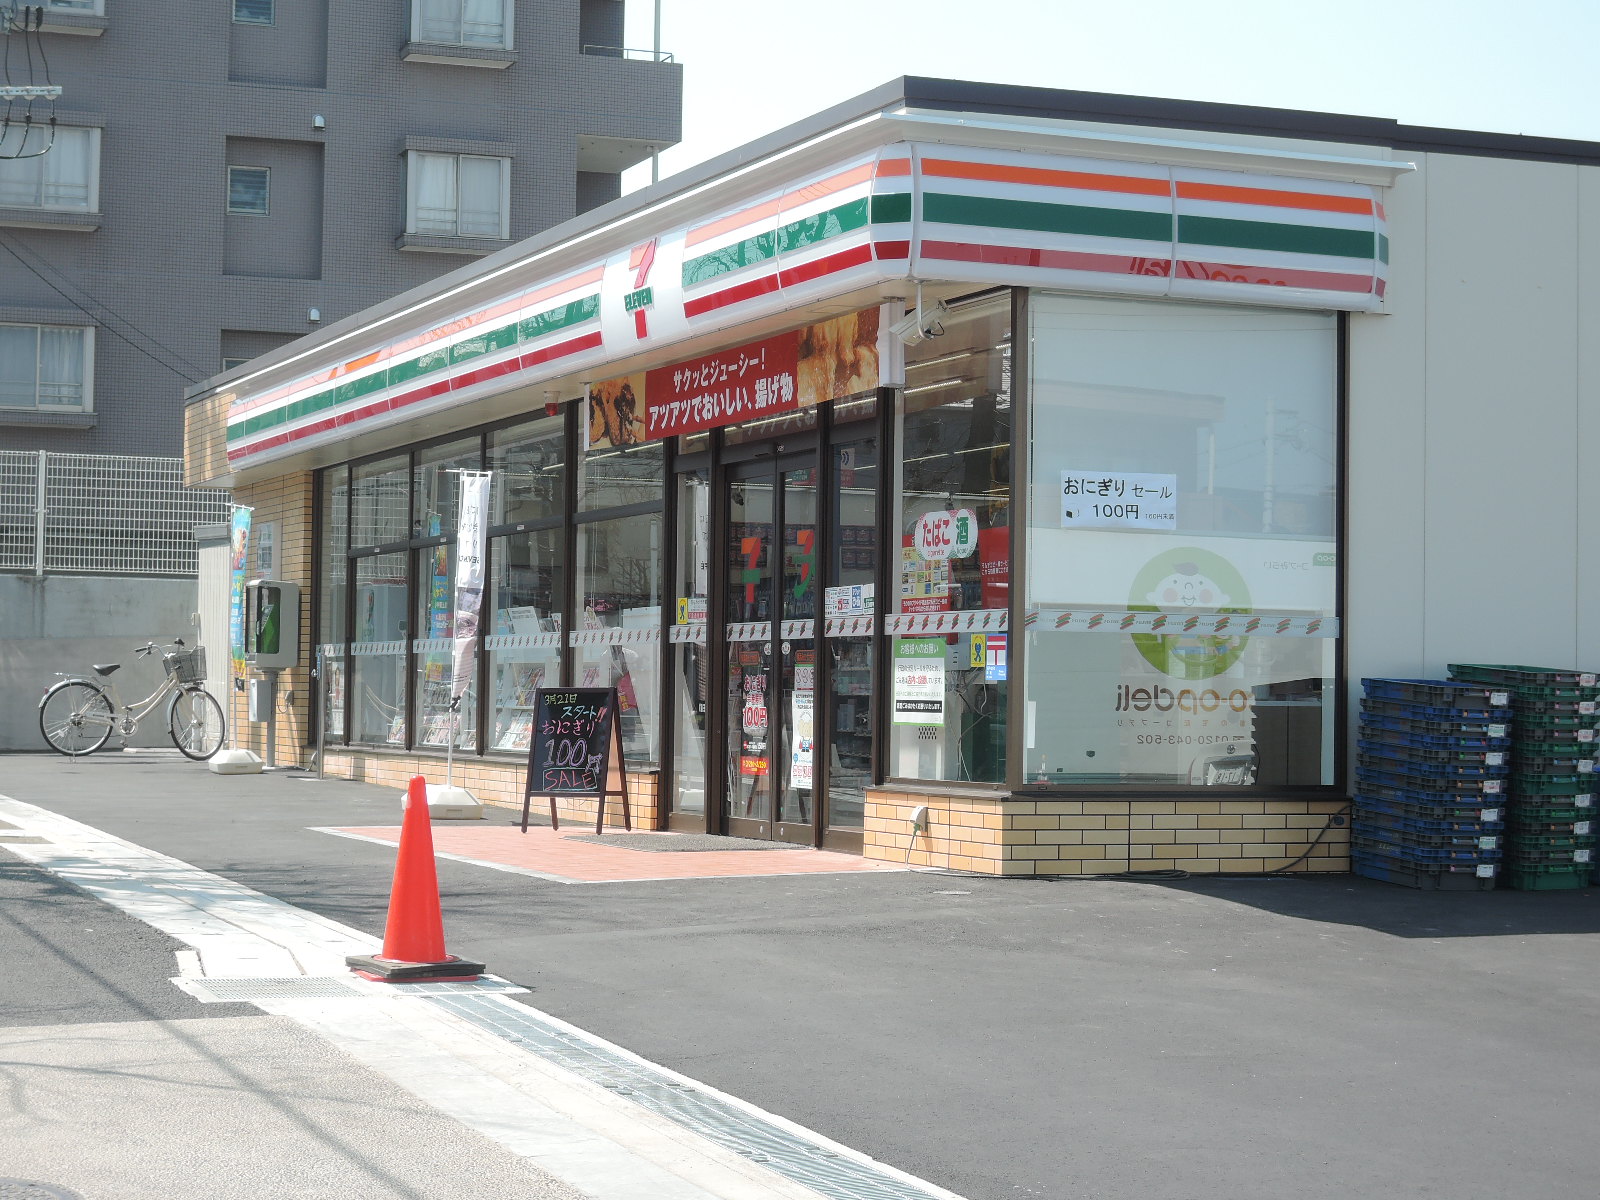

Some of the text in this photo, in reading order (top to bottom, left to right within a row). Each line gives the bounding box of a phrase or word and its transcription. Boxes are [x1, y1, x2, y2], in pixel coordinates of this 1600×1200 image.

[673, 347, 765, 393] サクッとジューシー！
[649, 372, 794, 431] アツアツでおいしい、揚げ物
[1064, 477, 1172, 498] おにぎり セール
[1092, 504, 1139, 519] 100円
[923, 516, 969, 547] たばこ 酒
[544, 693, 578, 706] 3月21日
[743, 706, 768, 728] 100円
[542, 719, 595, 738] おにぎり
[544, 770, 592, 791] SALE
